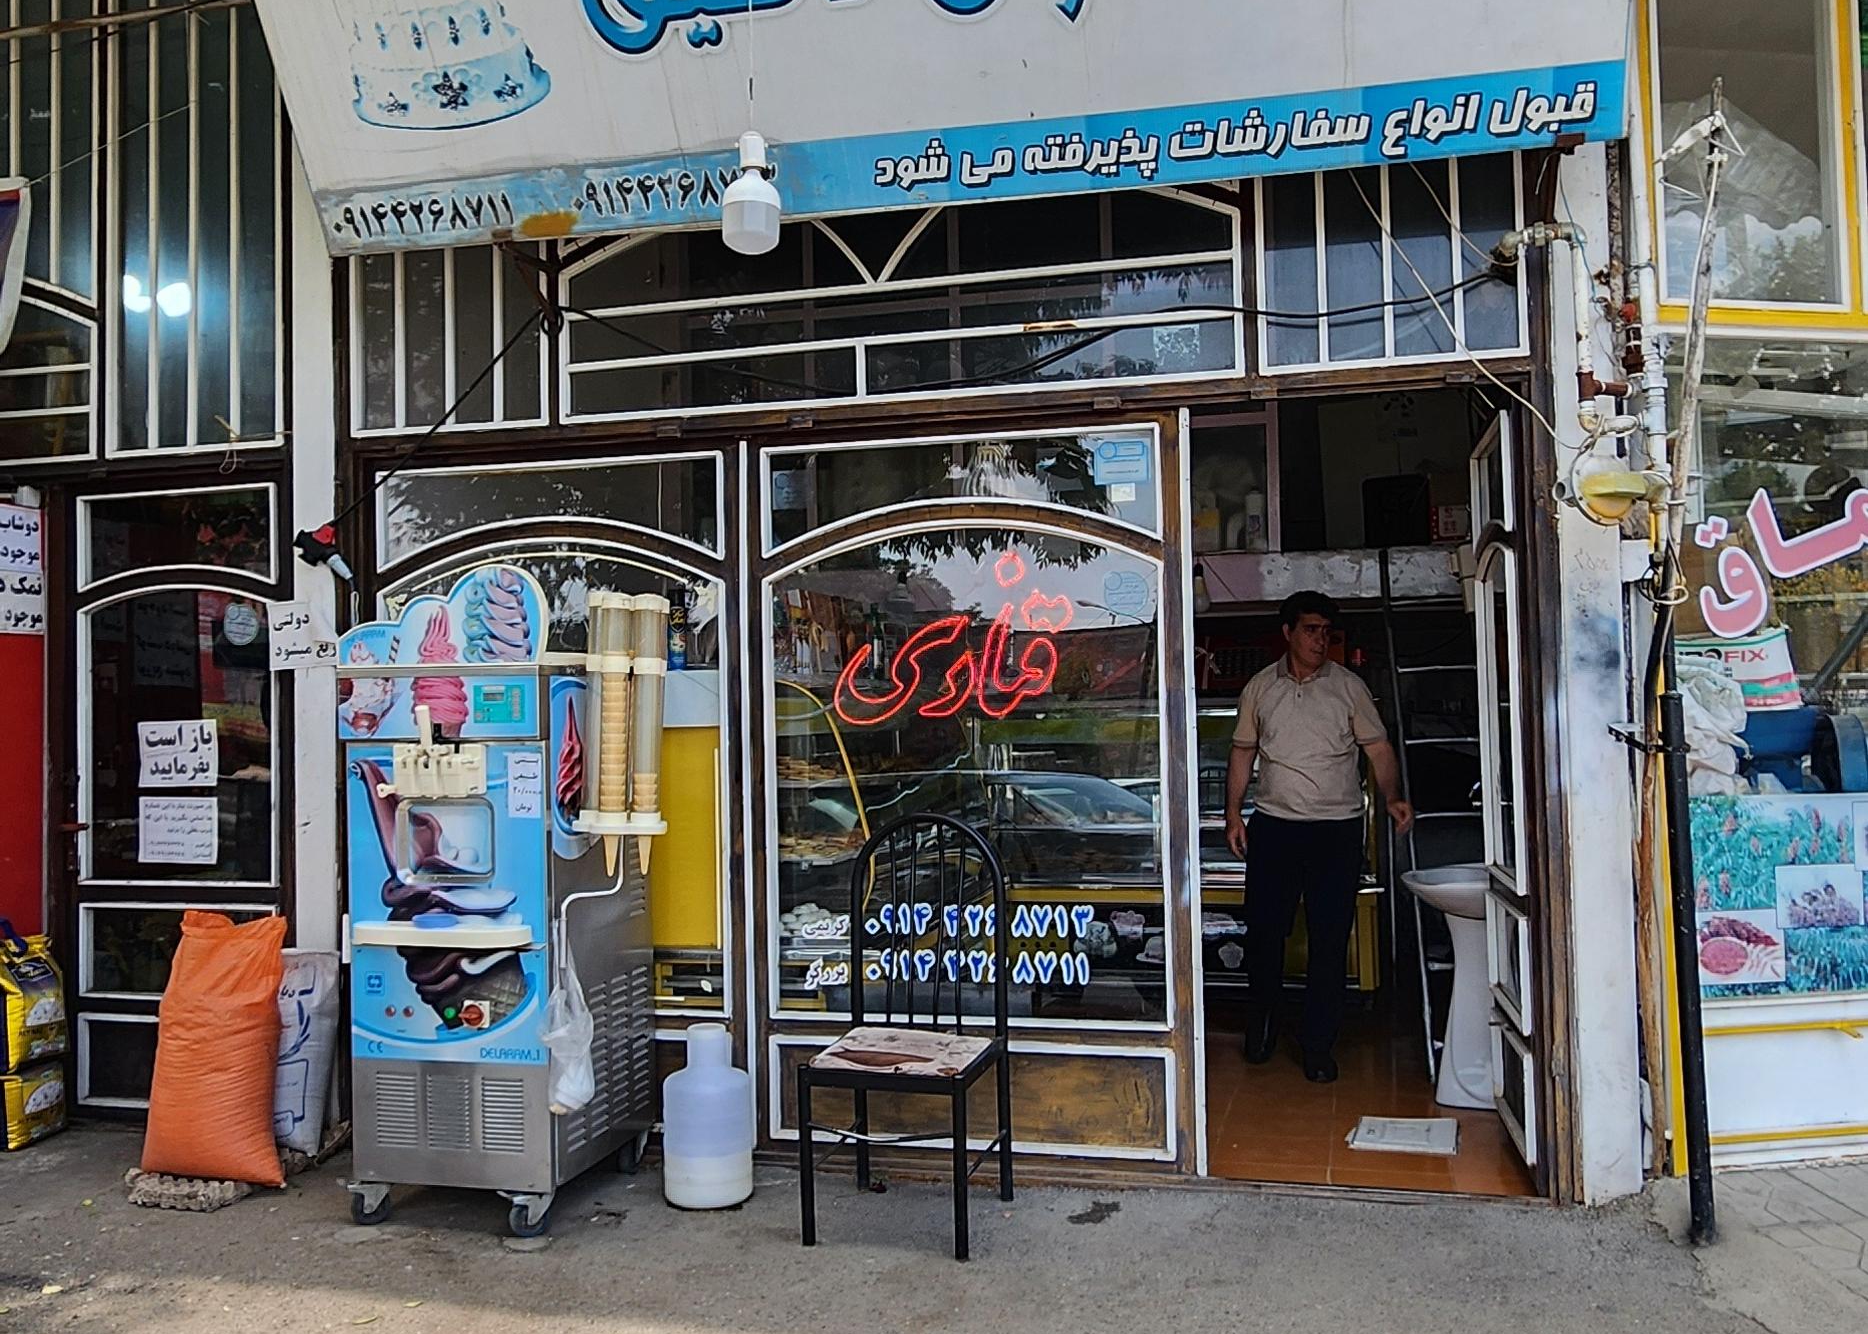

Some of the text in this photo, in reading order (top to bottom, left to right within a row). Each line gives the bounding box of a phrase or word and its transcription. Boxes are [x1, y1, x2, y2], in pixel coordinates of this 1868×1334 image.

[874, 80, 1598, 191] قبول انواع سفارشات پذیرفته می شود
[332, 190, 515, 239] ۰۹۱۴۴۲۶۸۷۱۱
[0, 546, 40, 565] موجود
[1696, 488, 1868, 638] ماق
[10, 575, 42, 596] نمک
[4, 609, 43, 628] موجود
[833, 550, 1074, 726] قنادی
[145, 723, 213, 753] باز است
[150, 755, 210, 781] بفرمایید
[801, 915, 849, 938] کریمی
[1011, 904, 1094, 938] ۸۷۱۳
[1012, 951, 1090, 985] ۸۷۱۱
